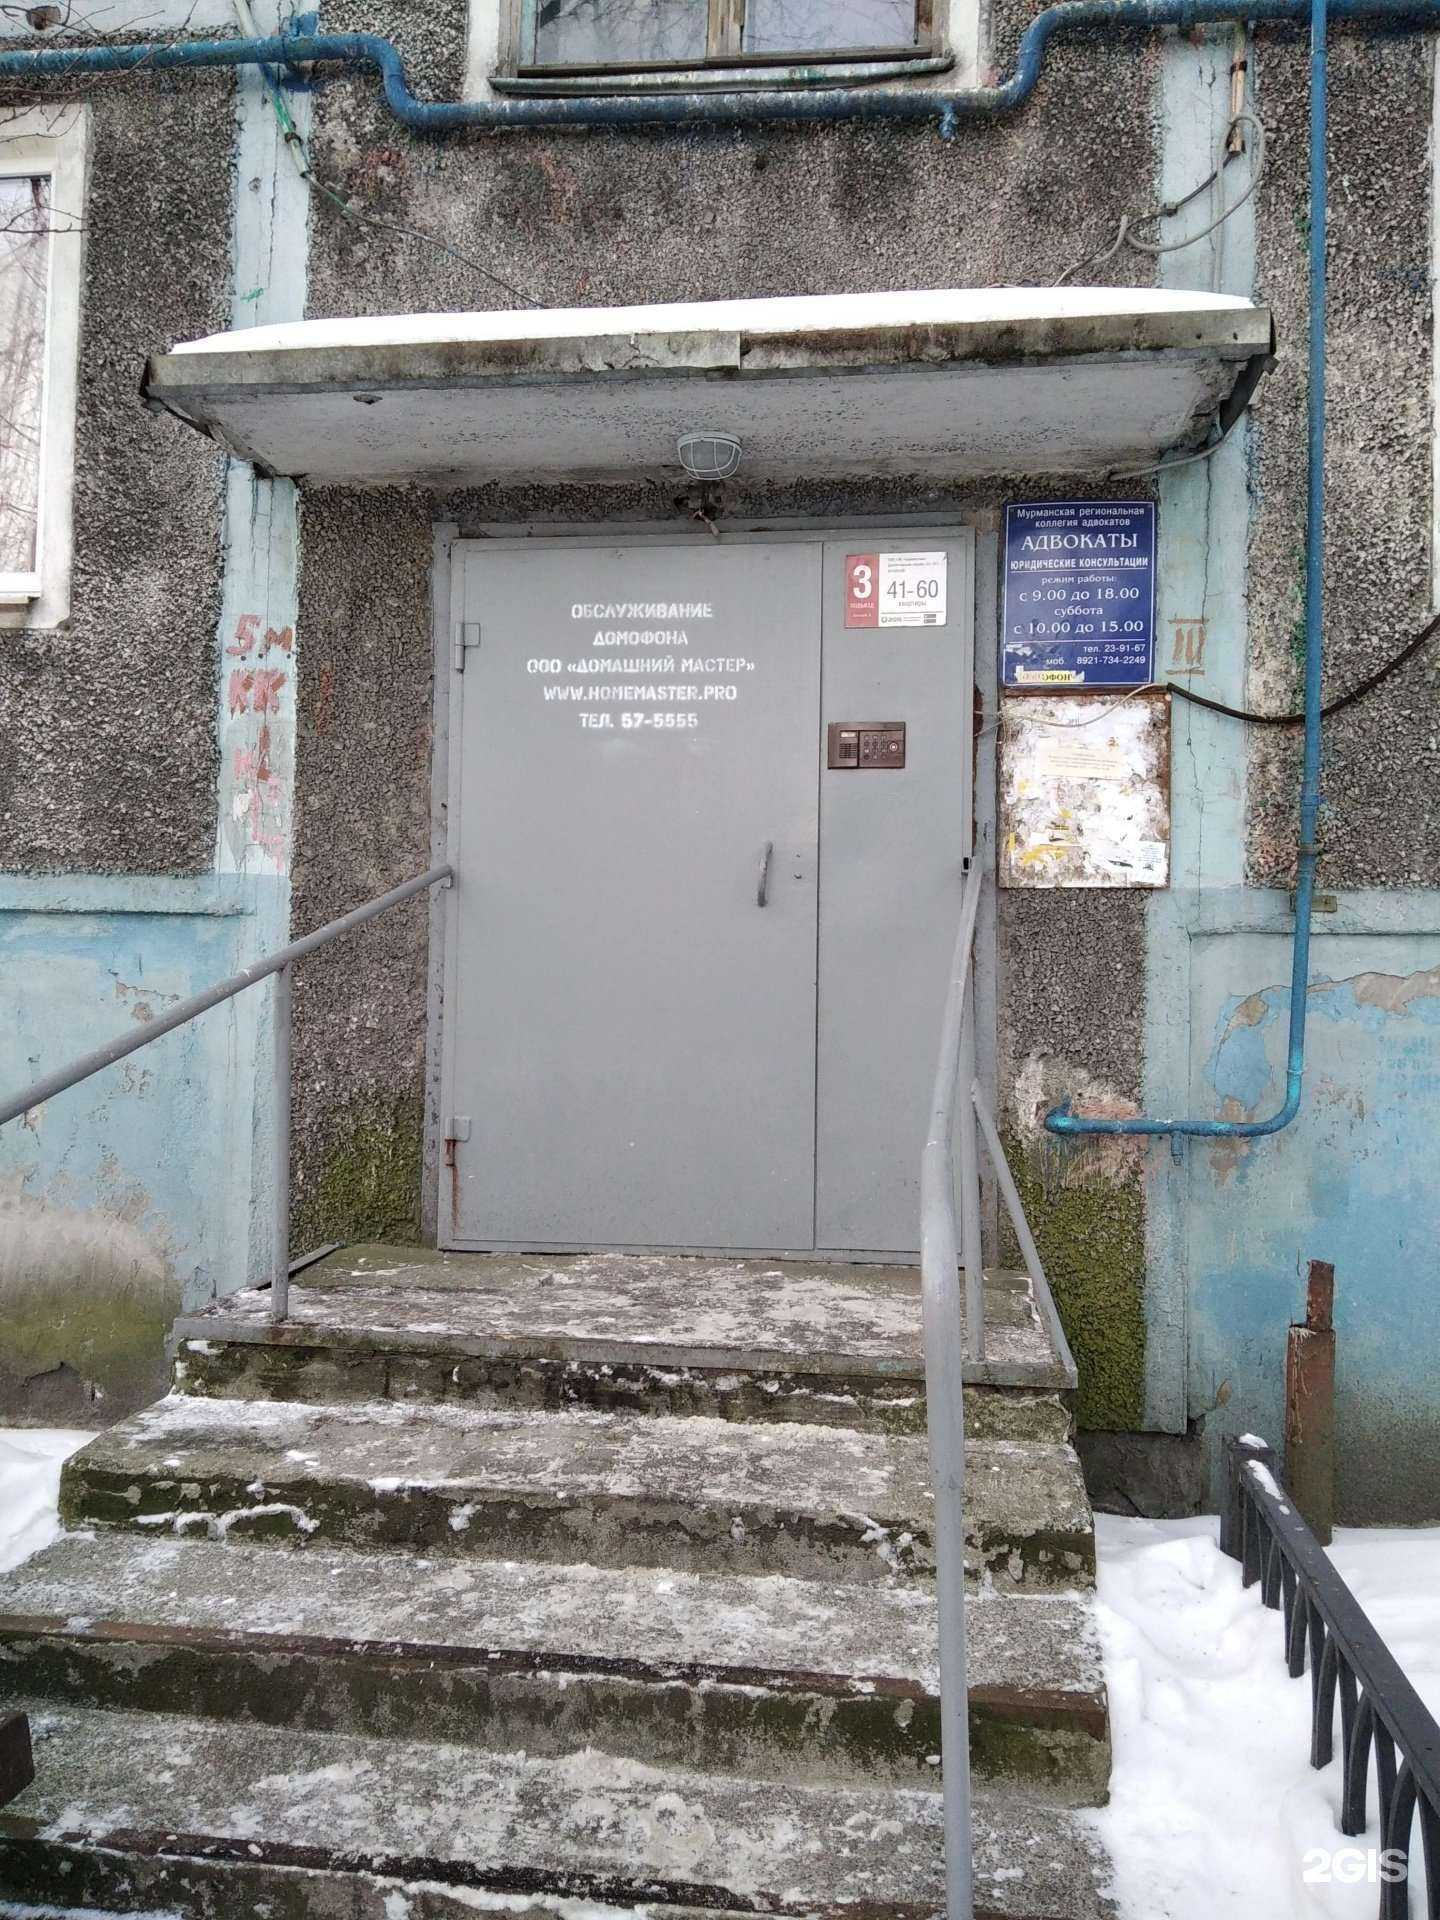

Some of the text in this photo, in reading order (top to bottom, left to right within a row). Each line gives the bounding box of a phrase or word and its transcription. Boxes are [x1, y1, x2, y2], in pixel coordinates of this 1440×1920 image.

[1017, 506, 1145, 519] Мурманская региональная
[1035, 517, 1131, 528] коллегия адвокатов
[1021, 533, 1138, 552] АДВОКАТЫ
[1010, 556, 1149, 571] ЮРИДИЧЕСКИЕ КОНСУЛЬТАЦИИ
[853, 564, 872, 599] 3
[1041, 576, 1075, 585] режим
[886, 579, 939, 599] 41-60
[1019, 587, 1140, 602] с 9.00 до 18.00
[571, 603, 713, 619] ОБСЛУЖИВАНИЕ
[1054, 605, 1104, 617] суббота
[1014, 620, 1144, 635] с 10.00 до 15.00
[592, 631, 689, 646] ДОМОФОНА
[1104, 643, 1146, 653] 23-91-67
[526, 655, 756, 674] ООО «ДОМАШНИЙ МАСТЕР»
[1076, 655, 1146, 665] 8921-734-2249
[543, 685, 738, 701] WWW.HOMEMASTER.PRO
[579, 712, 699, 729] ТЕЛ. 57-5555
